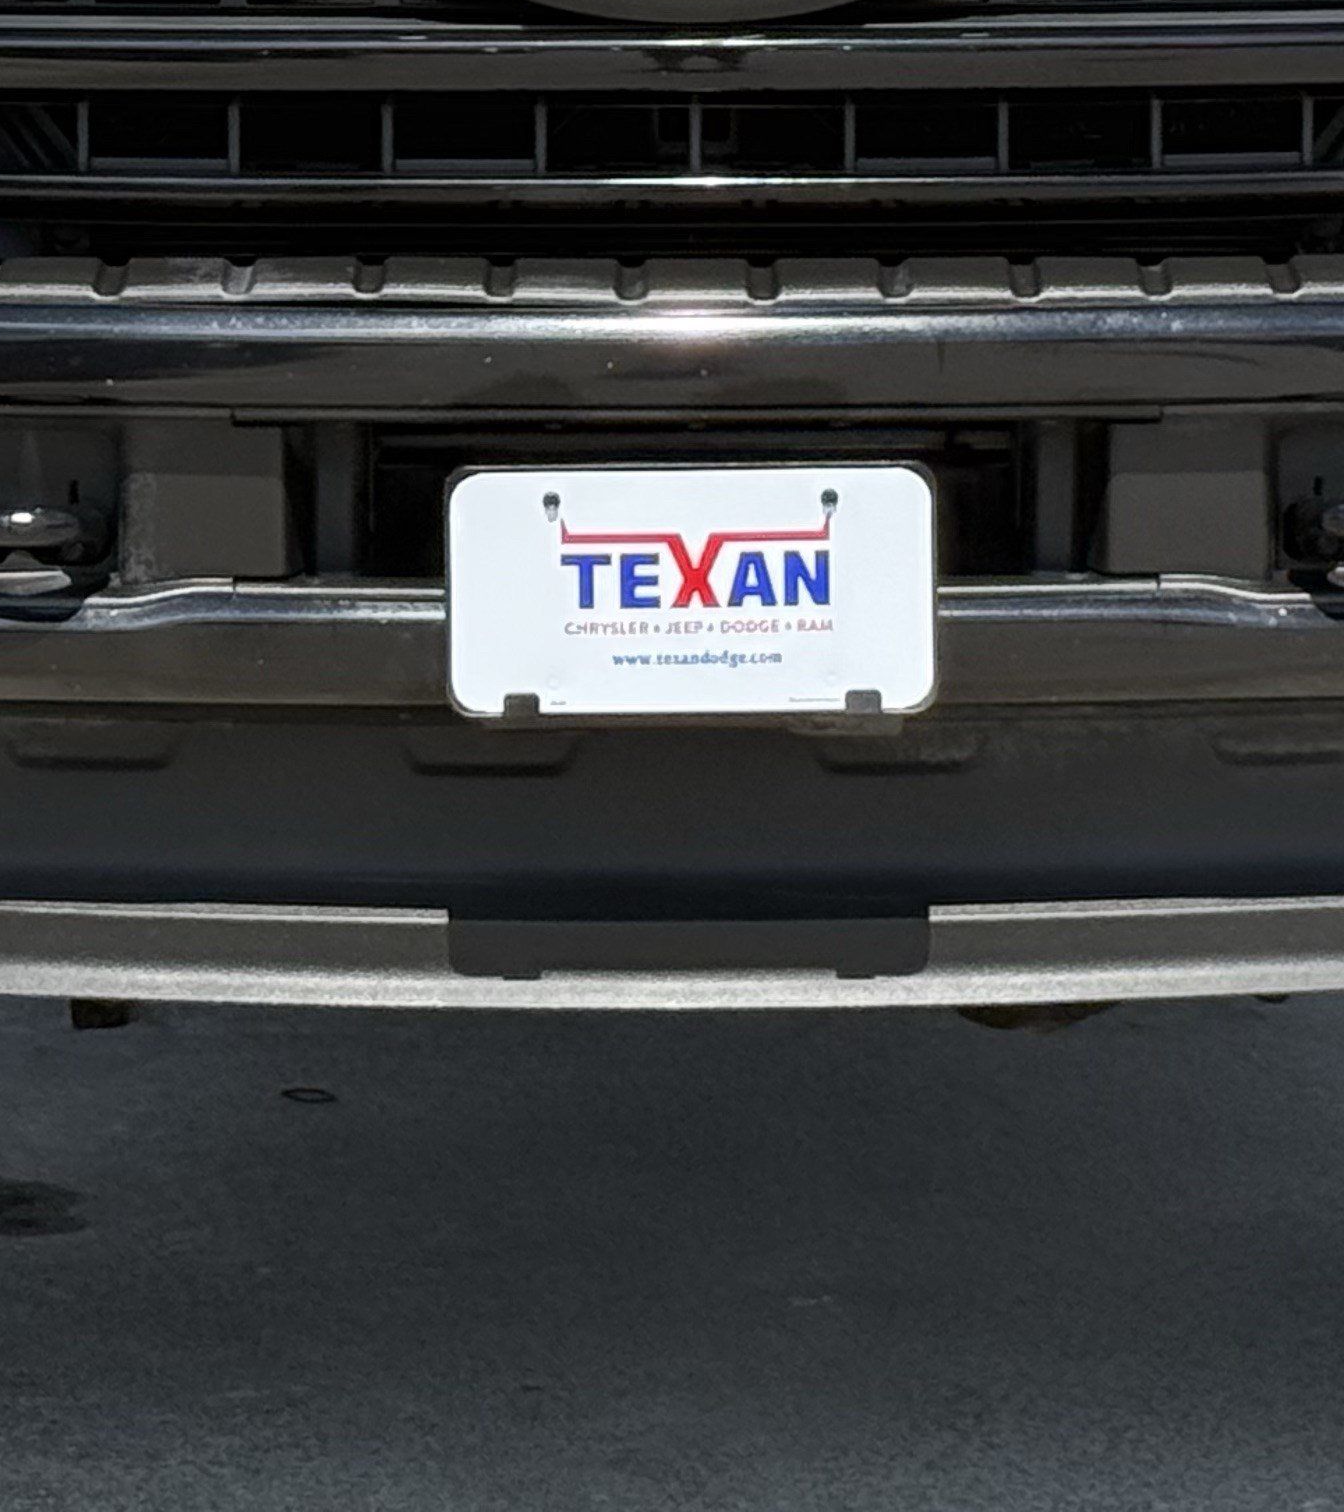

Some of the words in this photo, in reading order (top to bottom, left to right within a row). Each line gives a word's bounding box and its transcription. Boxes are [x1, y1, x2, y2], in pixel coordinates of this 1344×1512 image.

[560, 531, 831, 609] TEXAN
[564, 620, 650, 636] CHRYSLER
[665, 620, 703, 635] JEEP
[720, 619, 780, 634] DODGE
[797, 618, 834, 633] RAM
[612, 649, 783, 668] www.texandodge.com
